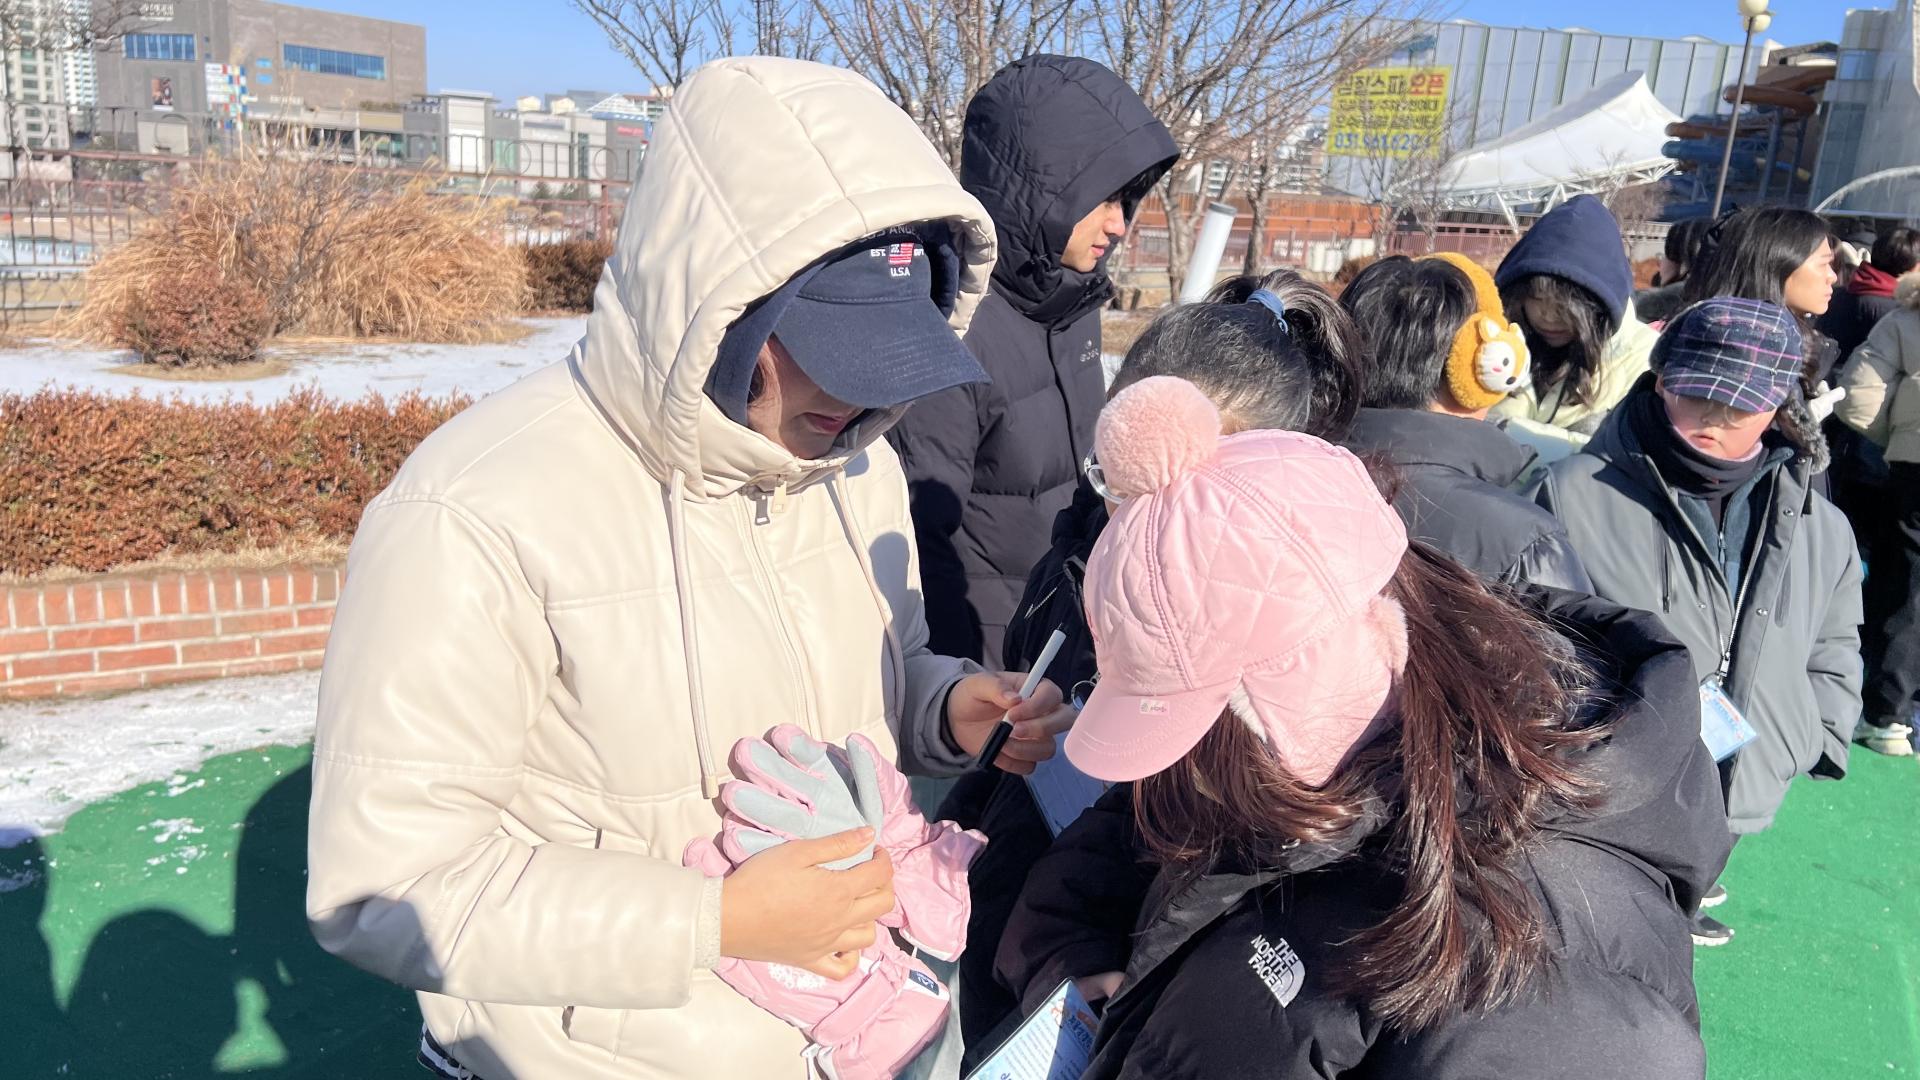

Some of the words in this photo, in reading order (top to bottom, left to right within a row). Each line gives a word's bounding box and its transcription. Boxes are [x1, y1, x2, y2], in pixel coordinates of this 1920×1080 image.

[1409, 73, 1444, 96] 오픈
[1250, 934, 1289, 978] NORTH
[1274, 937, 1300, 967] THE
[1247, 952, 1279, 988] FACE
